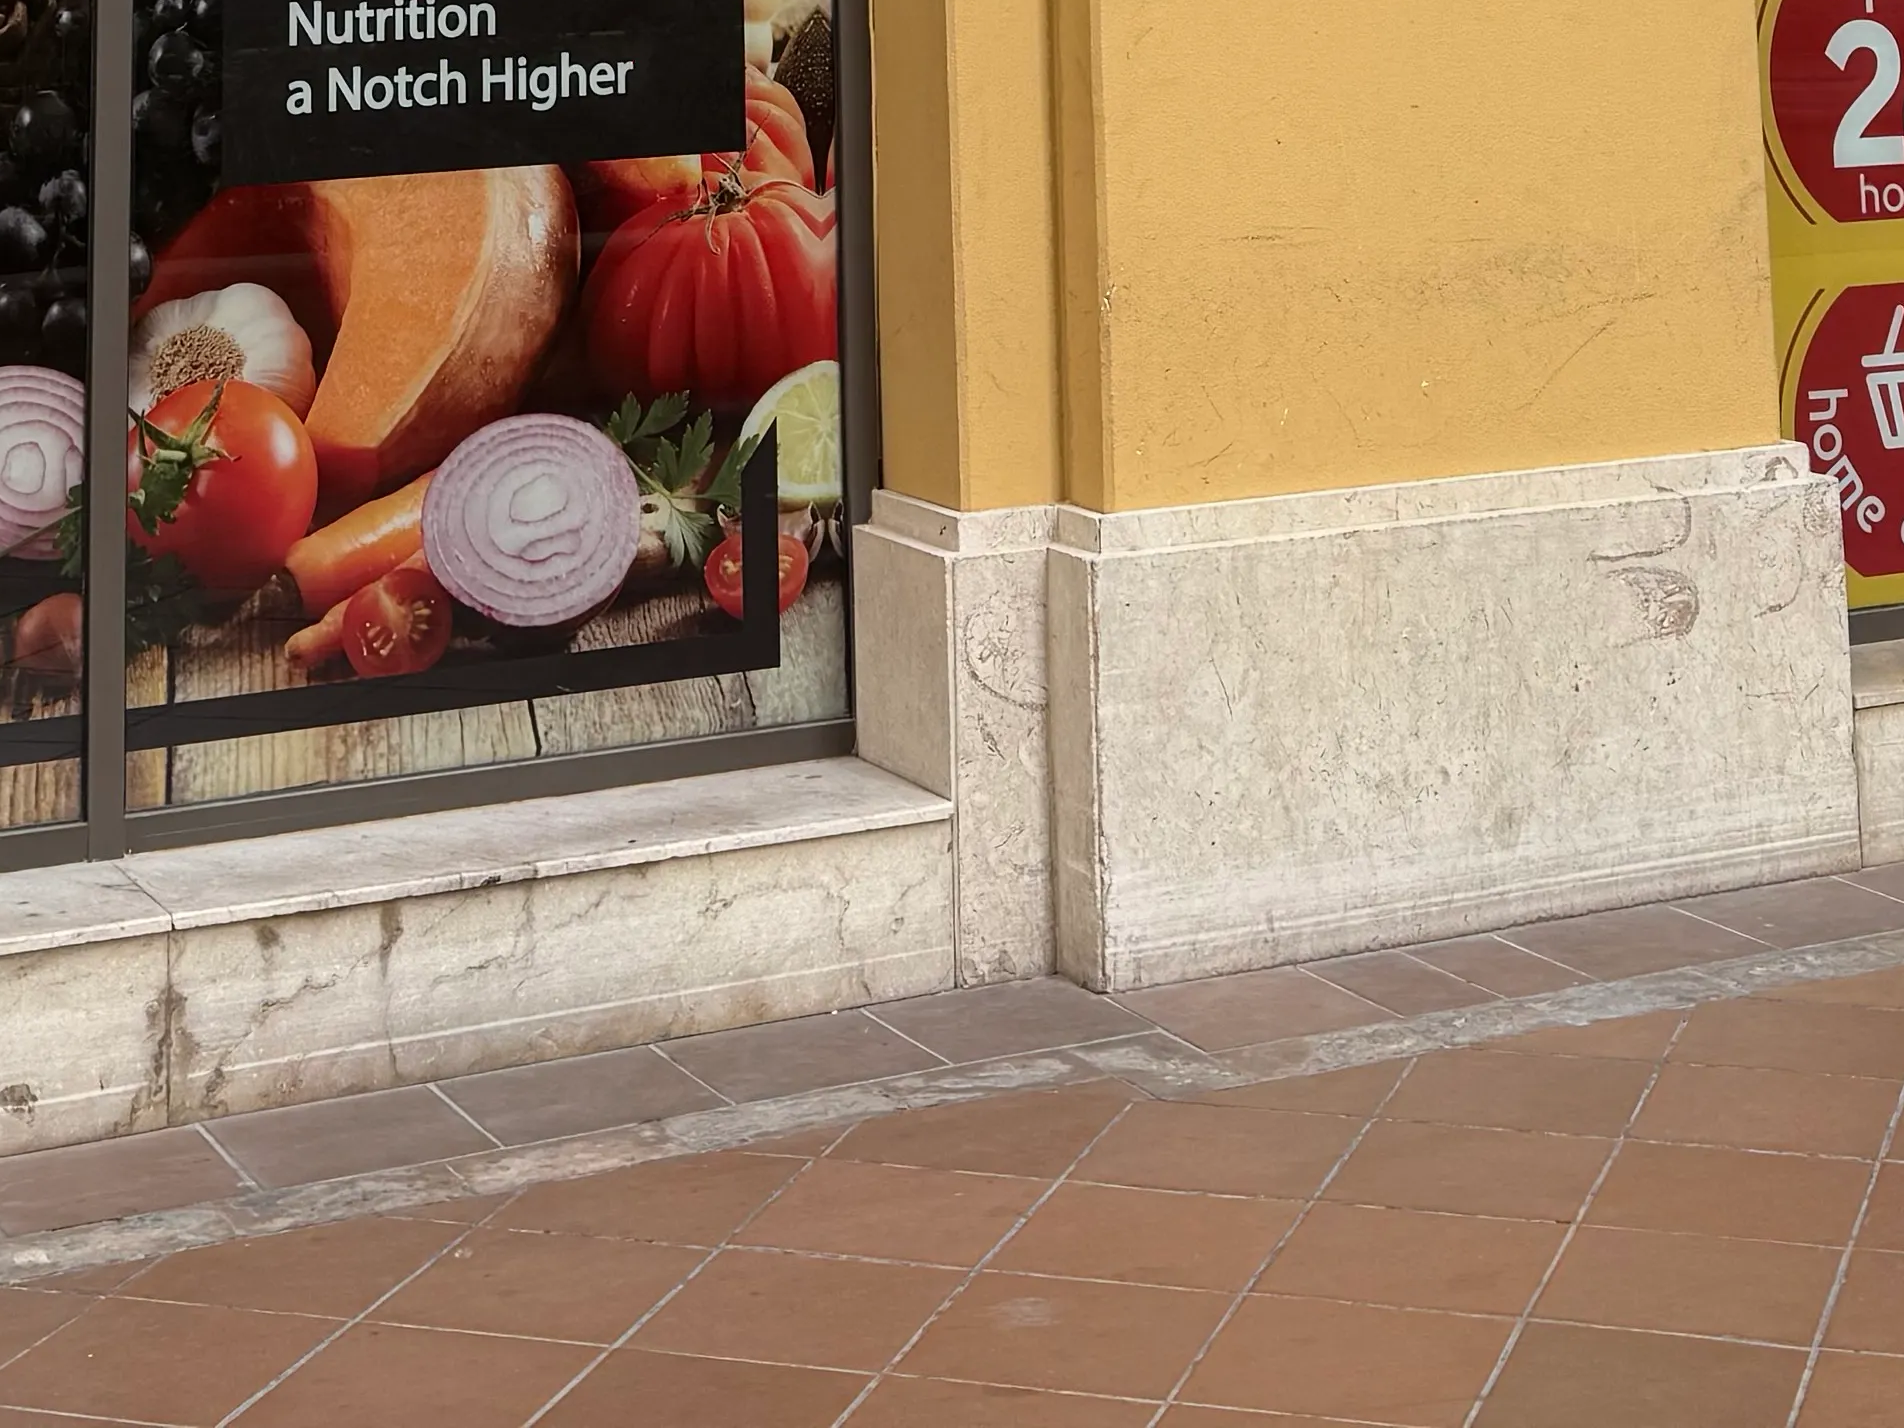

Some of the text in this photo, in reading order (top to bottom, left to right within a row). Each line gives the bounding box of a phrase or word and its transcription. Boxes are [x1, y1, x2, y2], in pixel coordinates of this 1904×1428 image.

[285, 51, 634, 115] a Notch Higher
[1807, 387, 1886, 535] home
